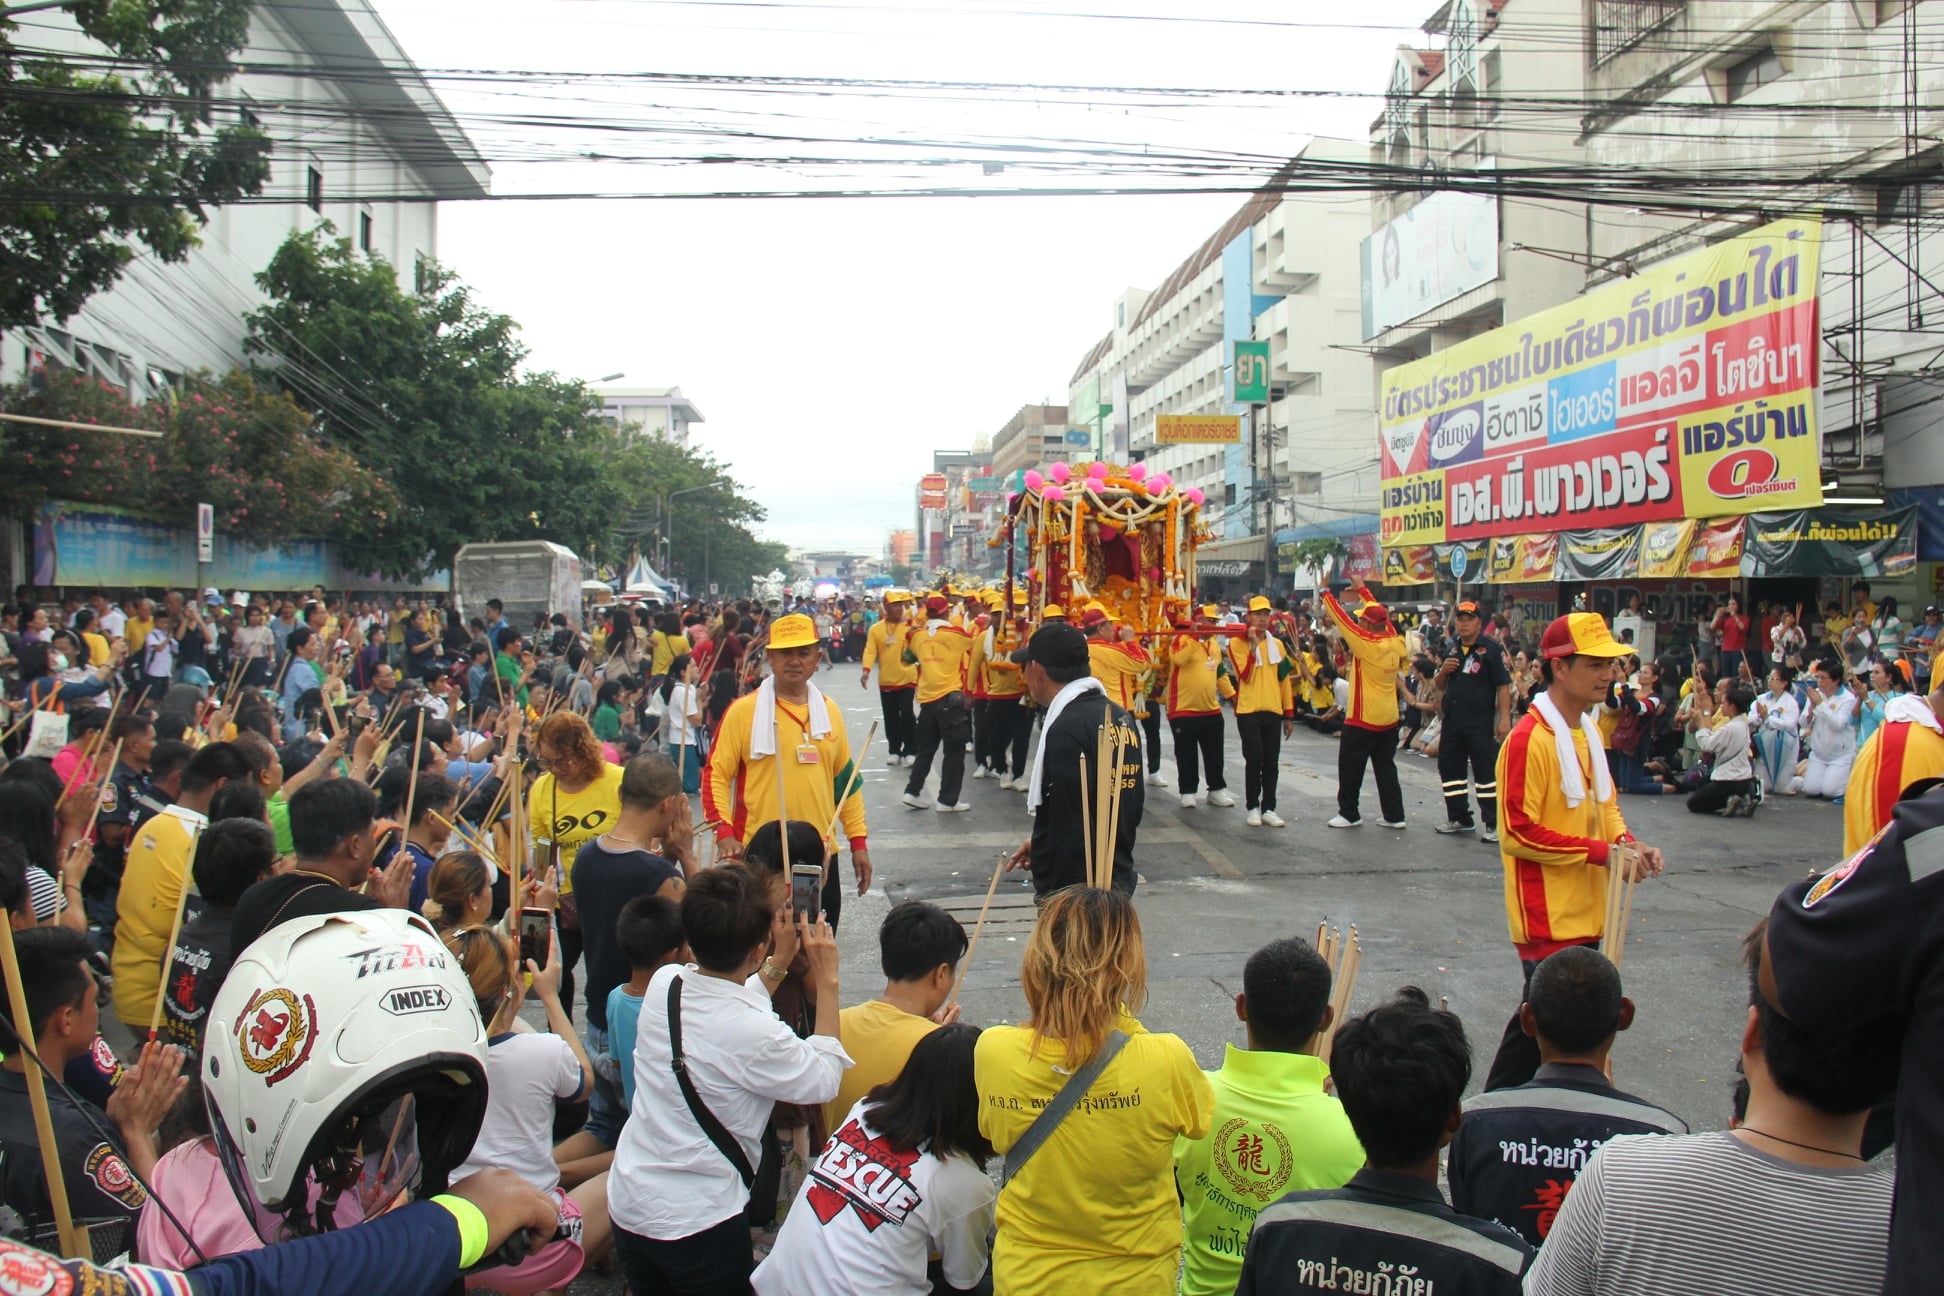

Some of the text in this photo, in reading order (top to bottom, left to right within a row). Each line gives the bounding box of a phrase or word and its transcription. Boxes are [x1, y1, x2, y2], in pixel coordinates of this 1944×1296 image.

[1385, 229, 1805, 422] บัตรประชาชนใบเดียวก็ผ่อนได้
[1237, 353, 1267, 388] ยา
[1619, 344, 1700, 407] แอลจี
[1711, 335, 1803, 397] โตชิบา
[1486, 393, 1543, 441] ฮิตาชิ
[1550, 376, 1615, 434] ไฮเออร์
[1682, 400, 1808, 456] แอร์บ้าน
[1383, 477, 1443, 509] แอร์บ้าน
[1451, 427, 1672, 528] เอส.พี.พาวเวอร์
[390, 989, 446, 1011] INDEX
[813, 1136, 920, 1220] RESCUE
[839, 1128, 900, 1172] SEARCH
[1231, 1132, 1271, 1176] 龍
